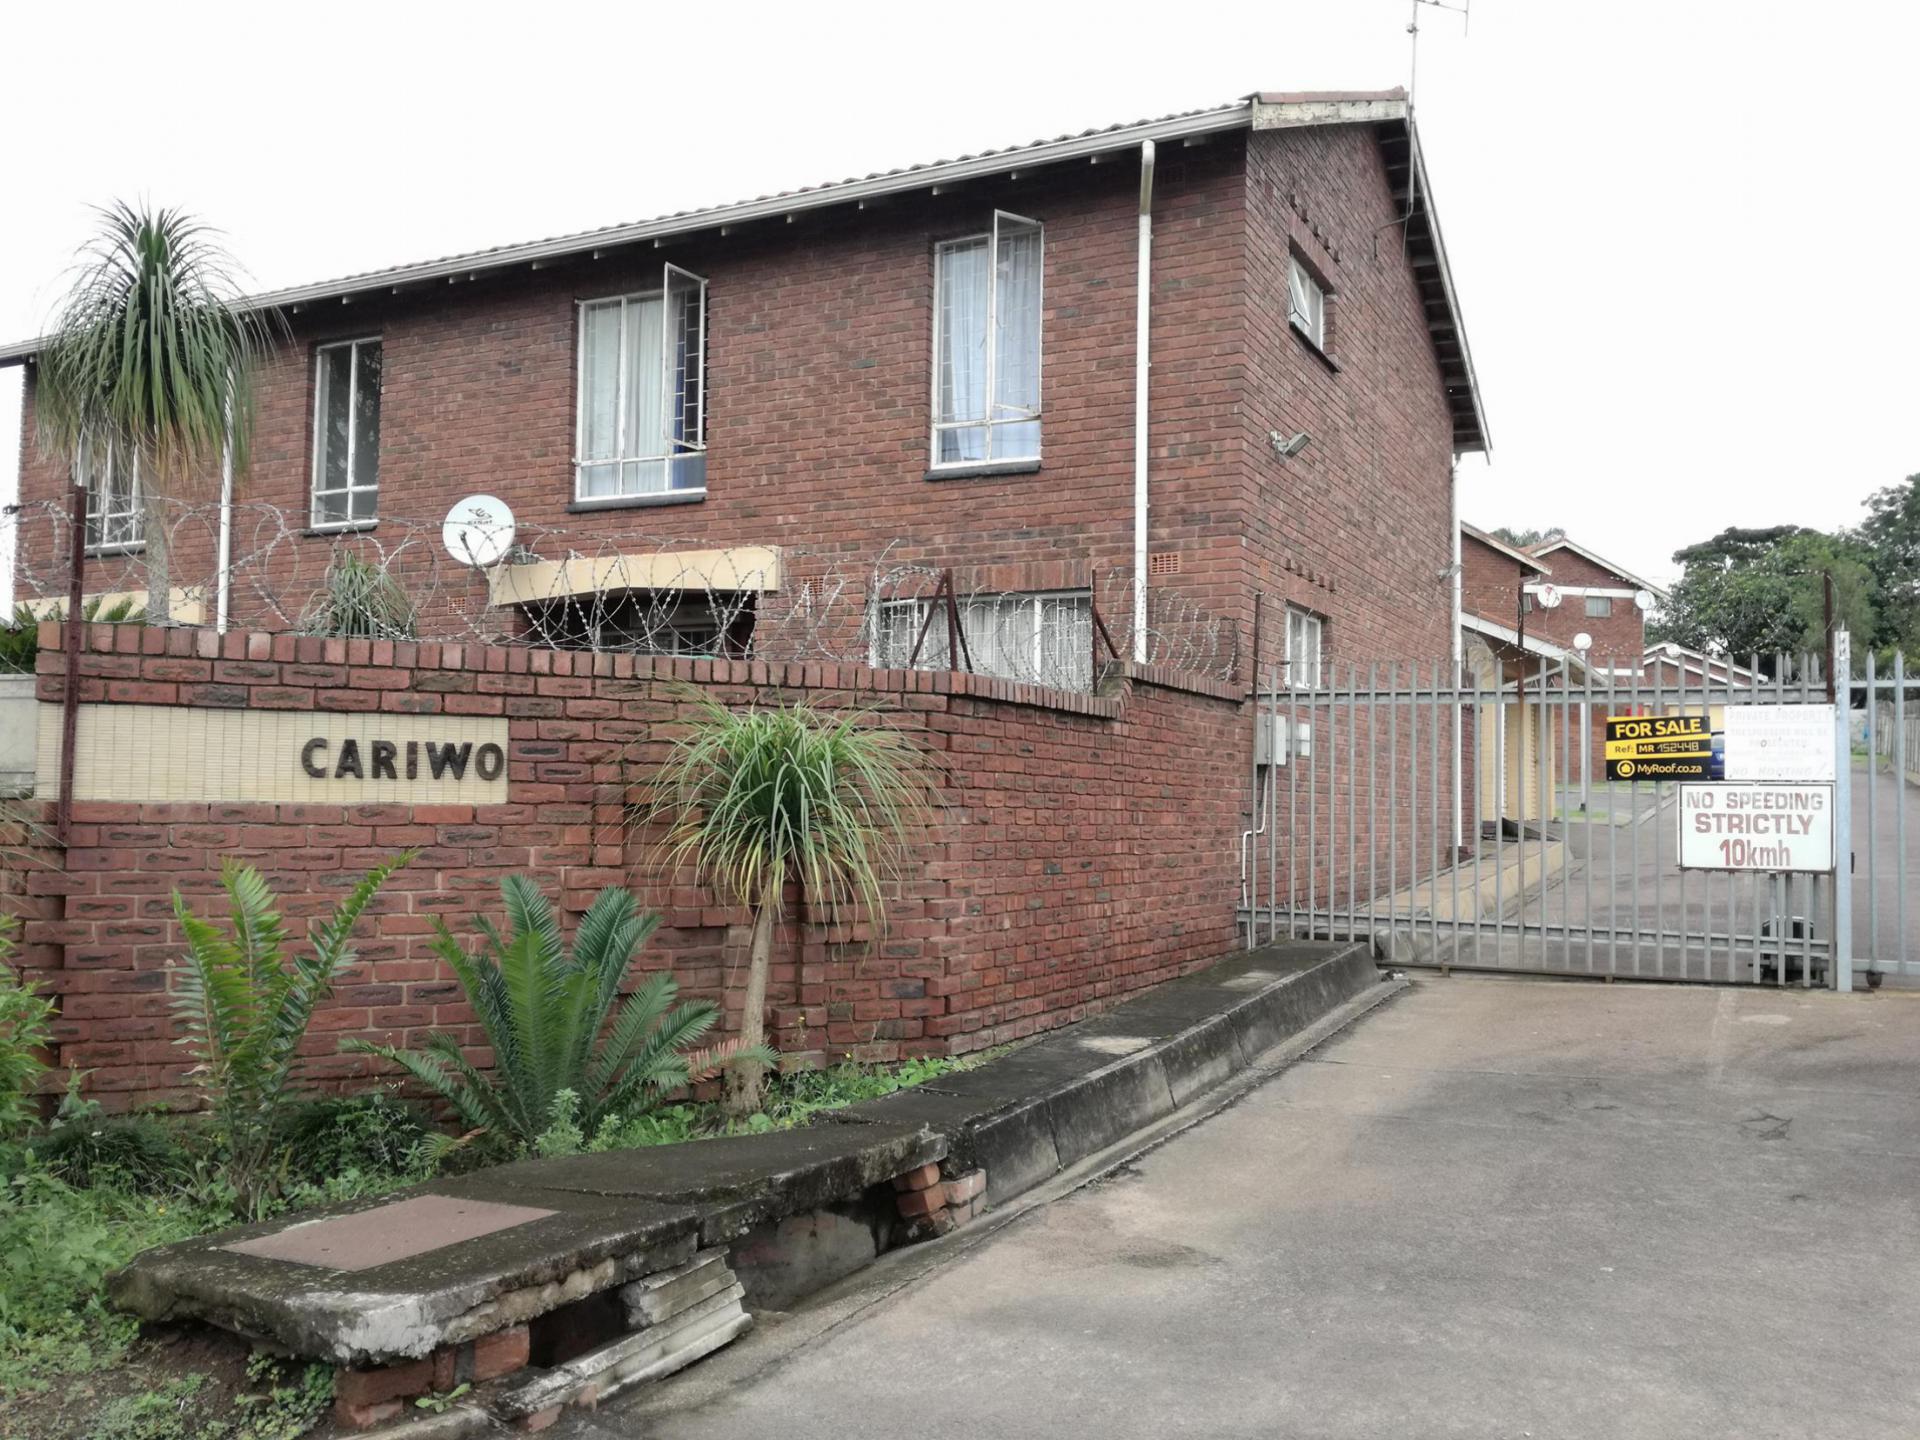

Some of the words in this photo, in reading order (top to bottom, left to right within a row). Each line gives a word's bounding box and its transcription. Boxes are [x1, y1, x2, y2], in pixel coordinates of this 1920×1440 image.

[1615, 723, 1652, 738] FOR
[1654, 719, 1702, 736] SALE
[1615, 745, 1635, 753] Ref:
[1639, 745, 1654, 753] MR
[1657, 742, 1699, 753] 152448
[300, 737, 505, 781] CARIWO
[1637, 763, 1702, 775] MyRoof.co.za
[1686, 791, 1714, 809] NO
[1726, 791, 1823, 810] SPEEDING
[1695, 812, 1815, 835] STRICTLY
[1719, 838, 1791, 867] 10kmh
